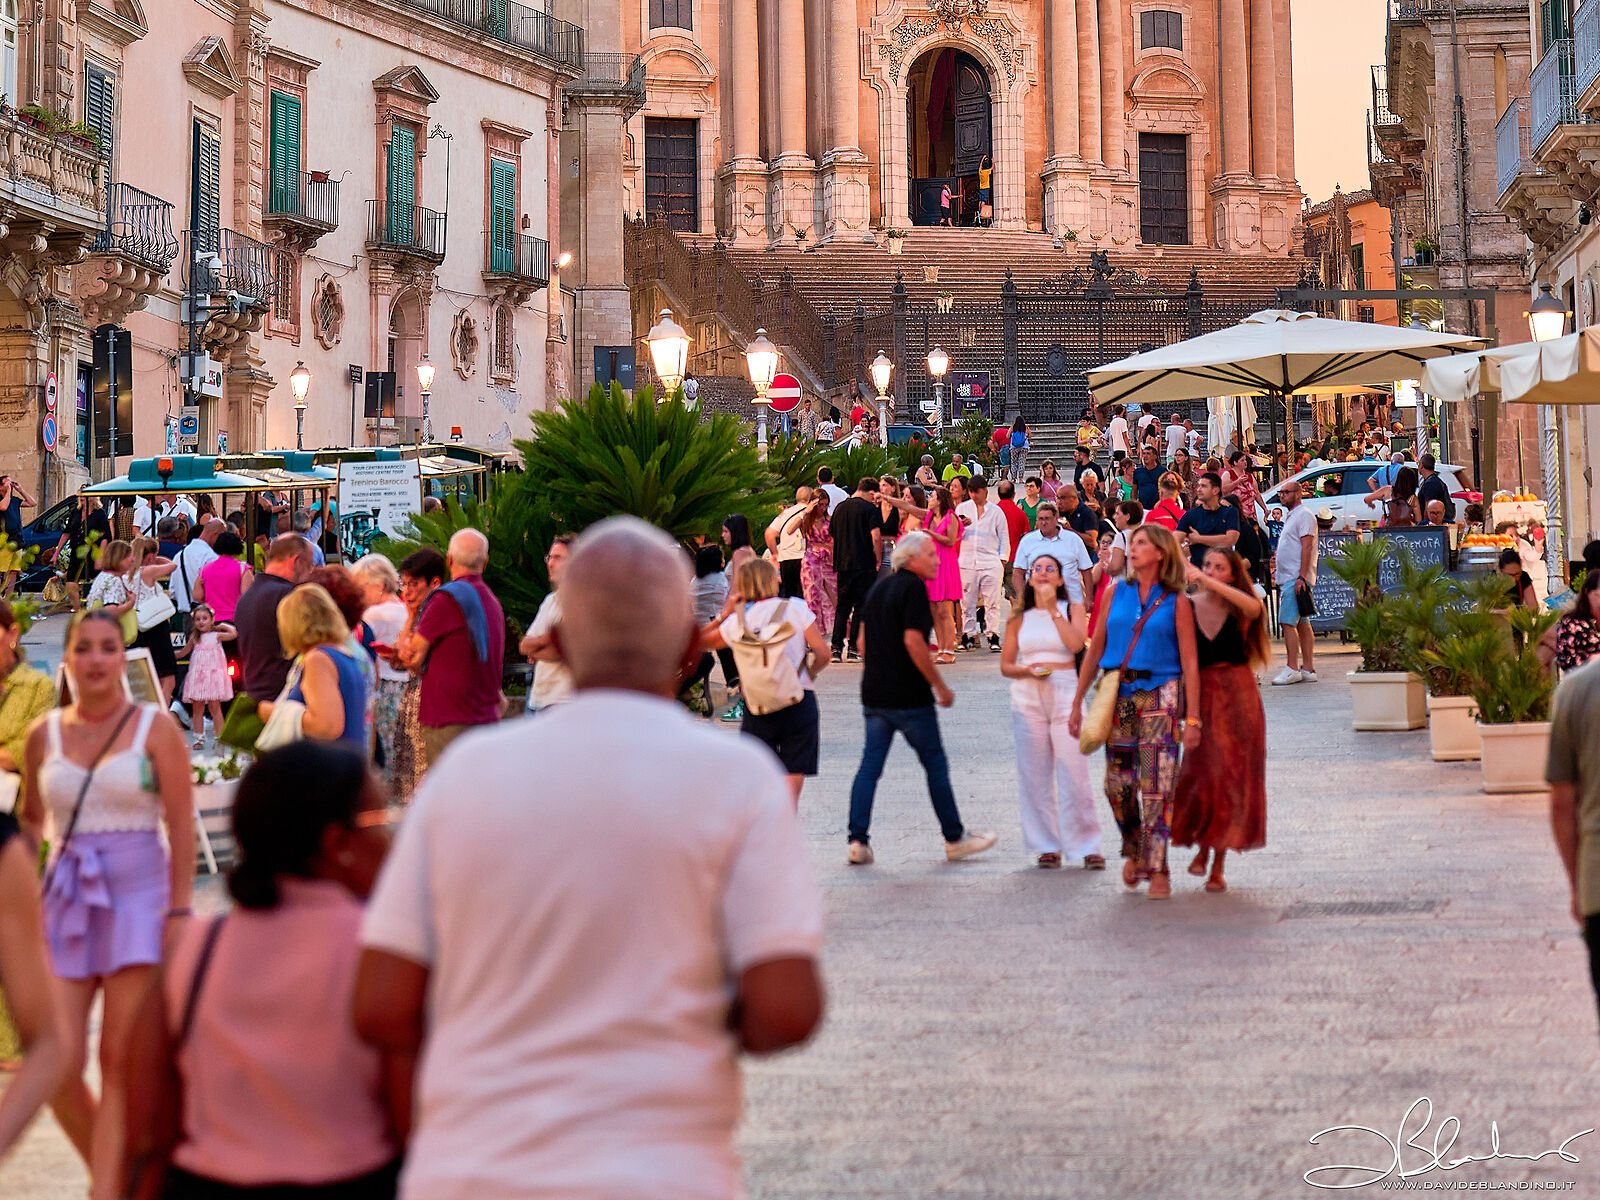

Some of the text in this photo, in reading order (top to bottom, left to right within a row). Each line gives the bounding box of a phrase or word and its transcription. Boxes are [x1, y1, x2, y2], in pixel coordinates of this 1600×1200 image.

[350, 478, 409, 487] Trenino Barocco
[431, 483, 467, 492] Baroco
